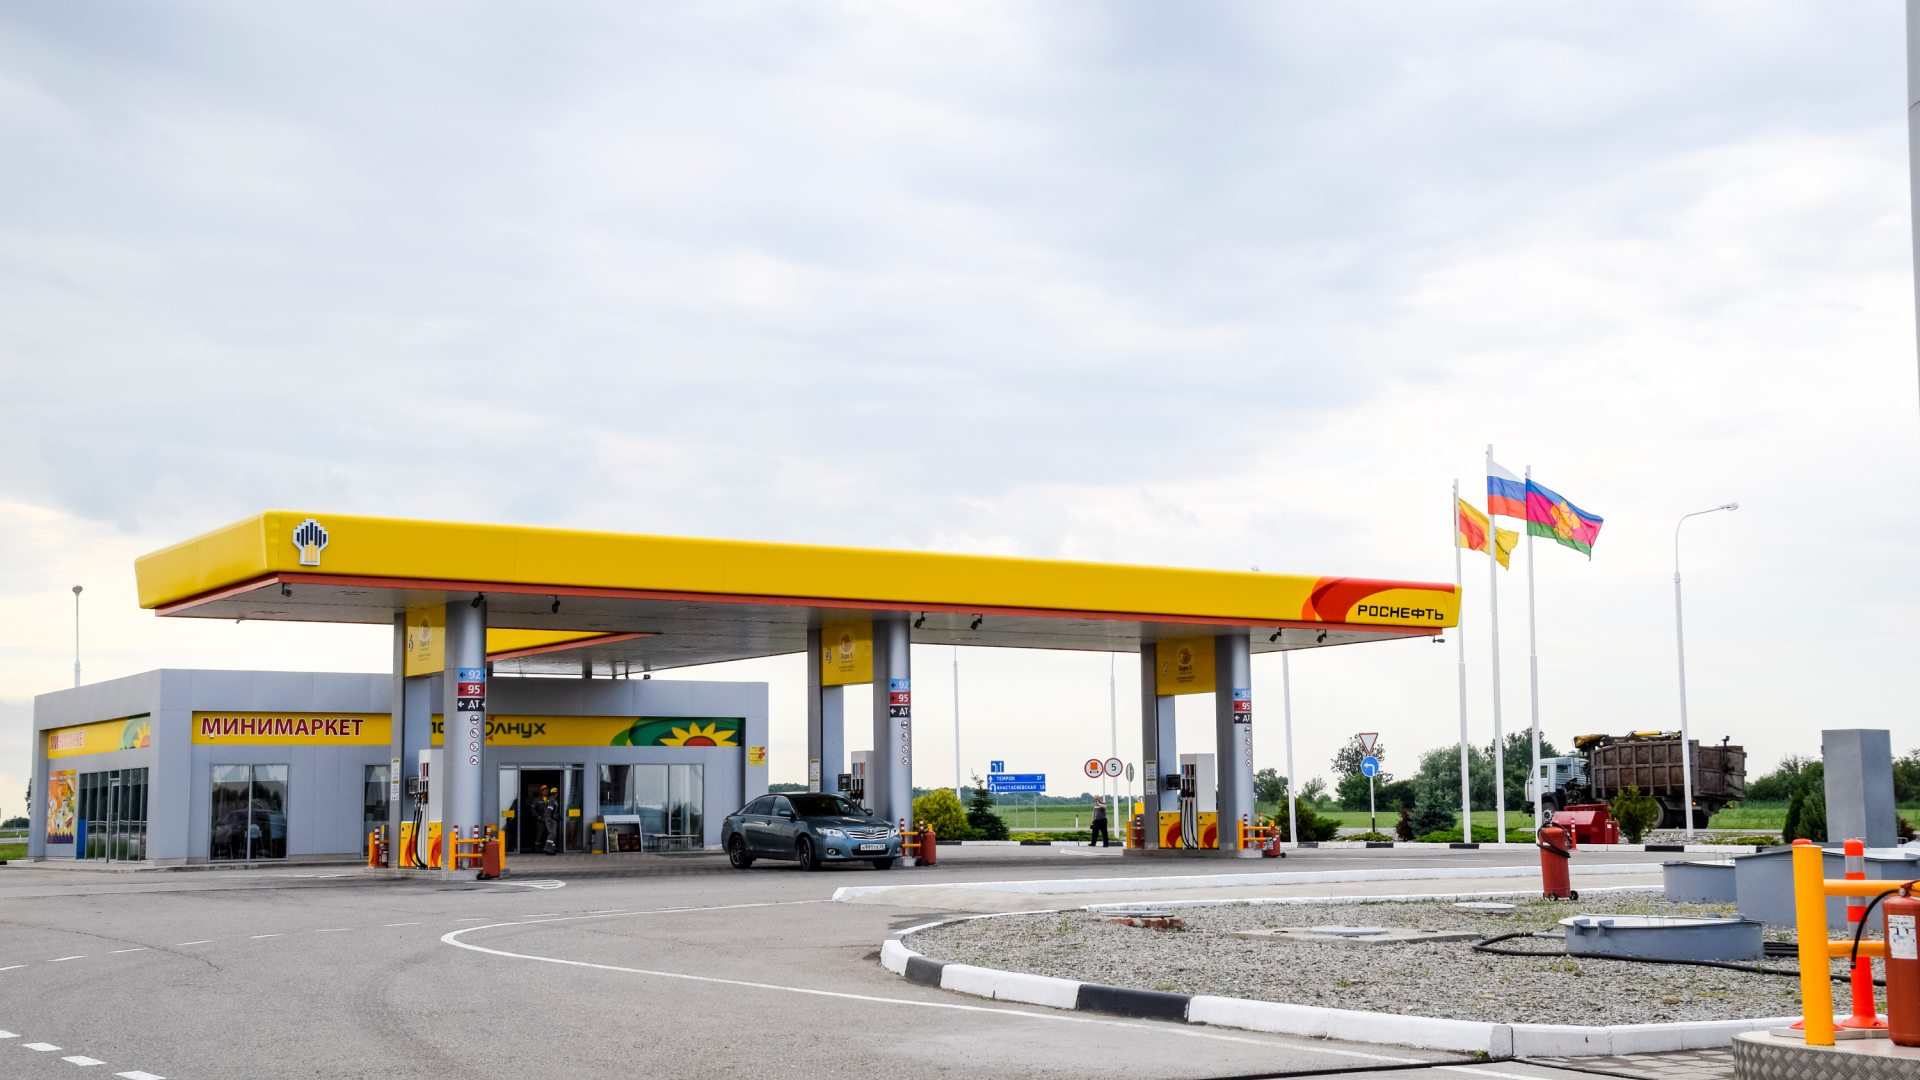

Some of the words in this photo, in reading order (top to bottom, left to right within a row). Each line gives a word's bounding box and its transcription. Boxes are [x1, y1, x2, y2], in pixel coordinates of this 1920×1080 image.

[1357, 604, 1444, 620] РОСНЕФТЬ
[825, 648, 832, 664] 4
[1161, 661, 1168, 675] 2
[468, 669, 481, 680] 92
[467, 684, 481, 694] 95
[898, 680, 909, 690] 92
[898, 693, 909, 703] 95
[1241, 690, 1251, 698] 92
[467, 699, 480, 710] ДТ
[1241, 702, 1251, 710] 95
[898, 707, 909, 716] ДТ
[1242, 714, 1251, 722] ДТ
[200, 717, 364, 736] МИНИМАРКЕТ
[1111, 763, 1117, 771] 5
